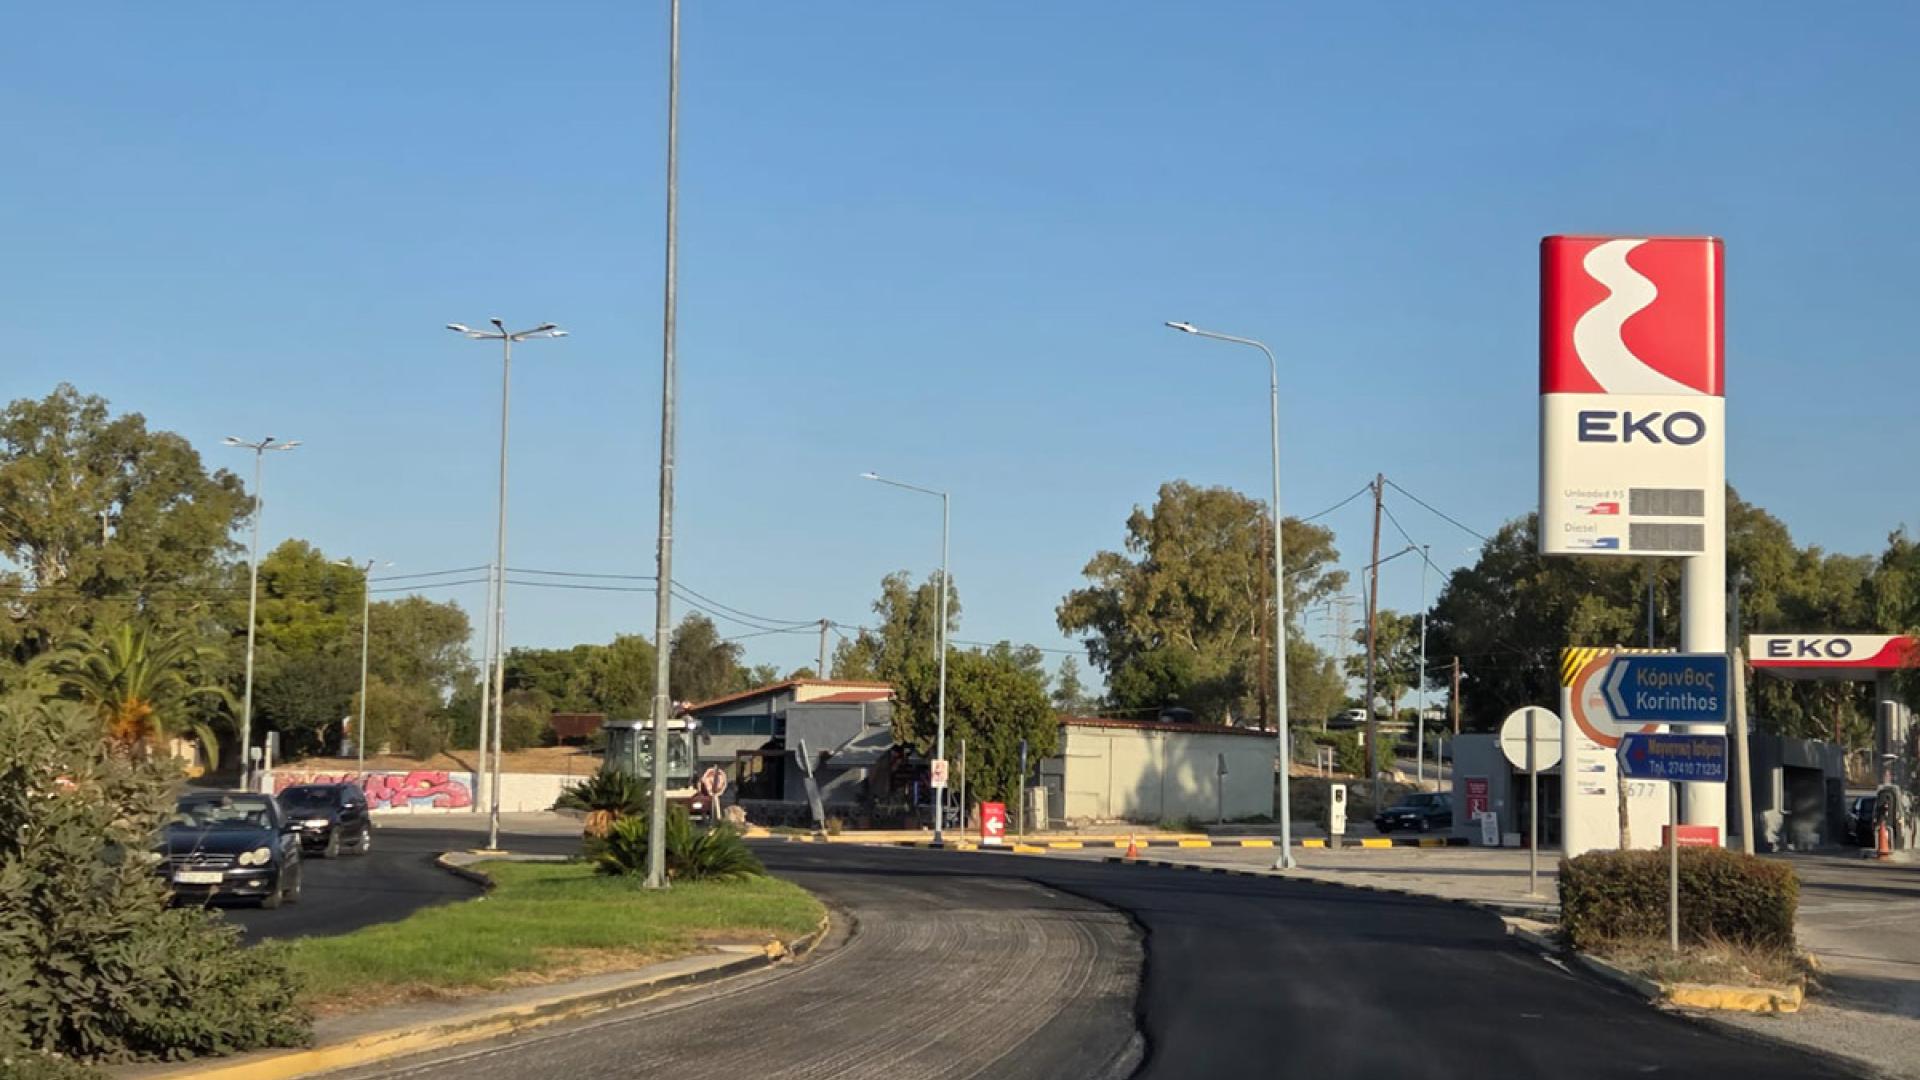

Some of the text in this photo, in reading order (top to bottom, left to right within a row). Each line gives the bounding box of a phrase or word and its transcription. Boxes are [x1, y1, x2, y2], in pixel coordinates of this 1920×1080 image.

[1578, 410, 1706, 445] EKO
[1564, 489, 1625, 499] Unleaded 95
[1564, 522, 1597, 532] Diesel
[1767, 638, 1852, 658] EKO
[1637, 667, 1715, 691] Κόρινθος
[1636, 691, 1718, 711] Korinthos
